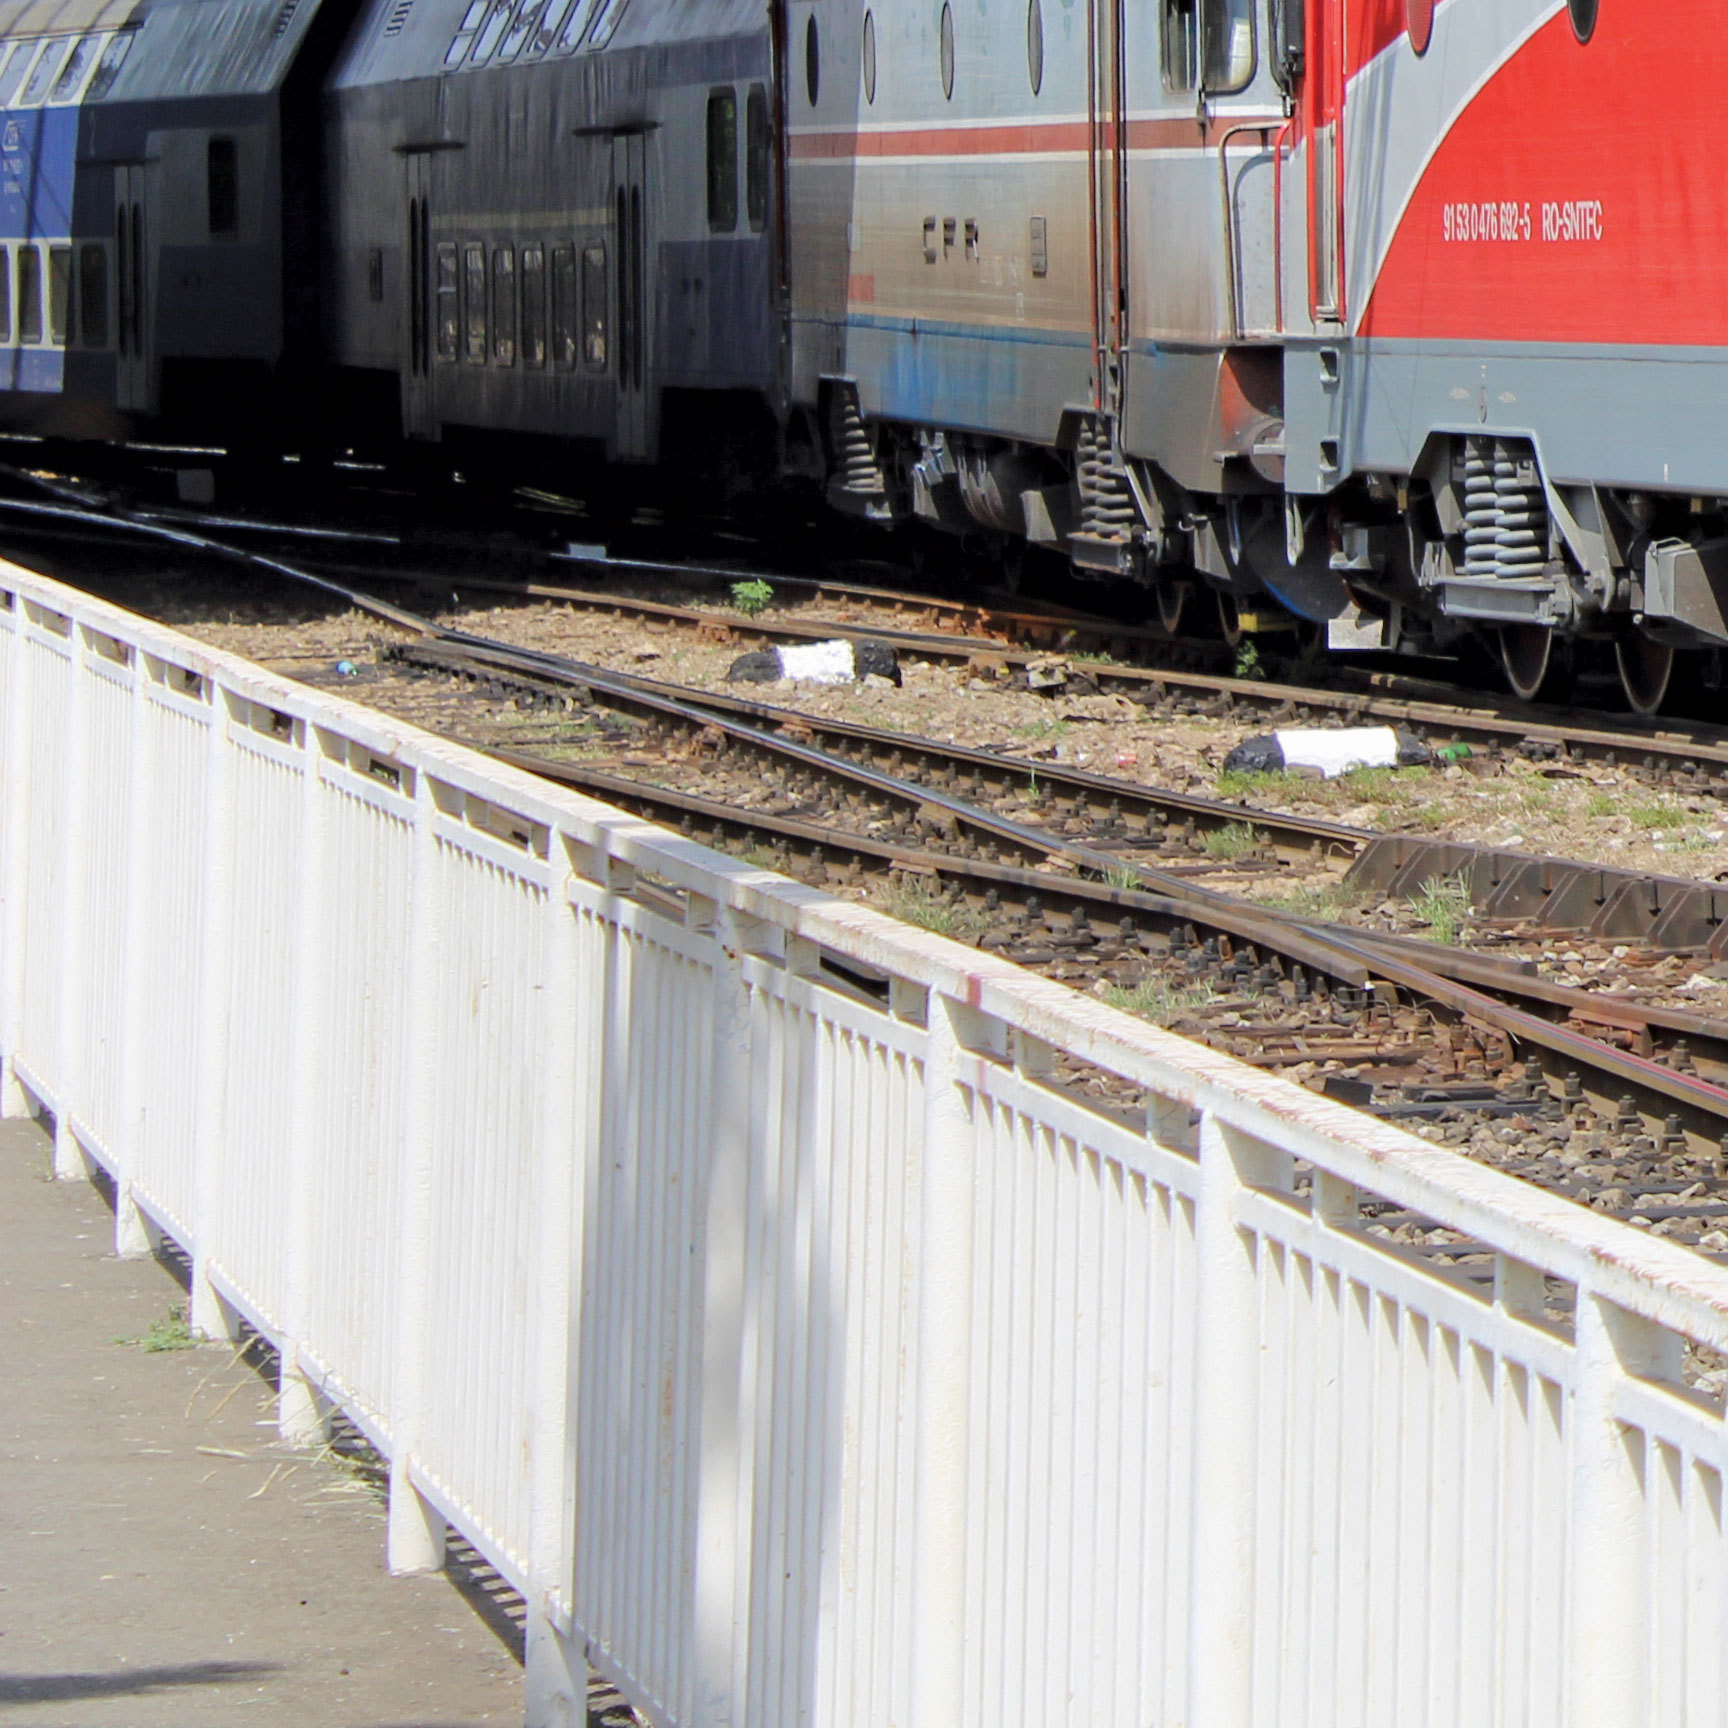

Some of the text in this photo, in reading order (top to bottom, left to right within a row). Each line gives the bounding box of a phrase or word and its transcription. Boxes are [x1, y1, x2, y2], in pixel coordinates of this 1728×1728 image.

[1443, 200, 1603, 242] 91 53 0 476 692-5 RO-SNTFC
